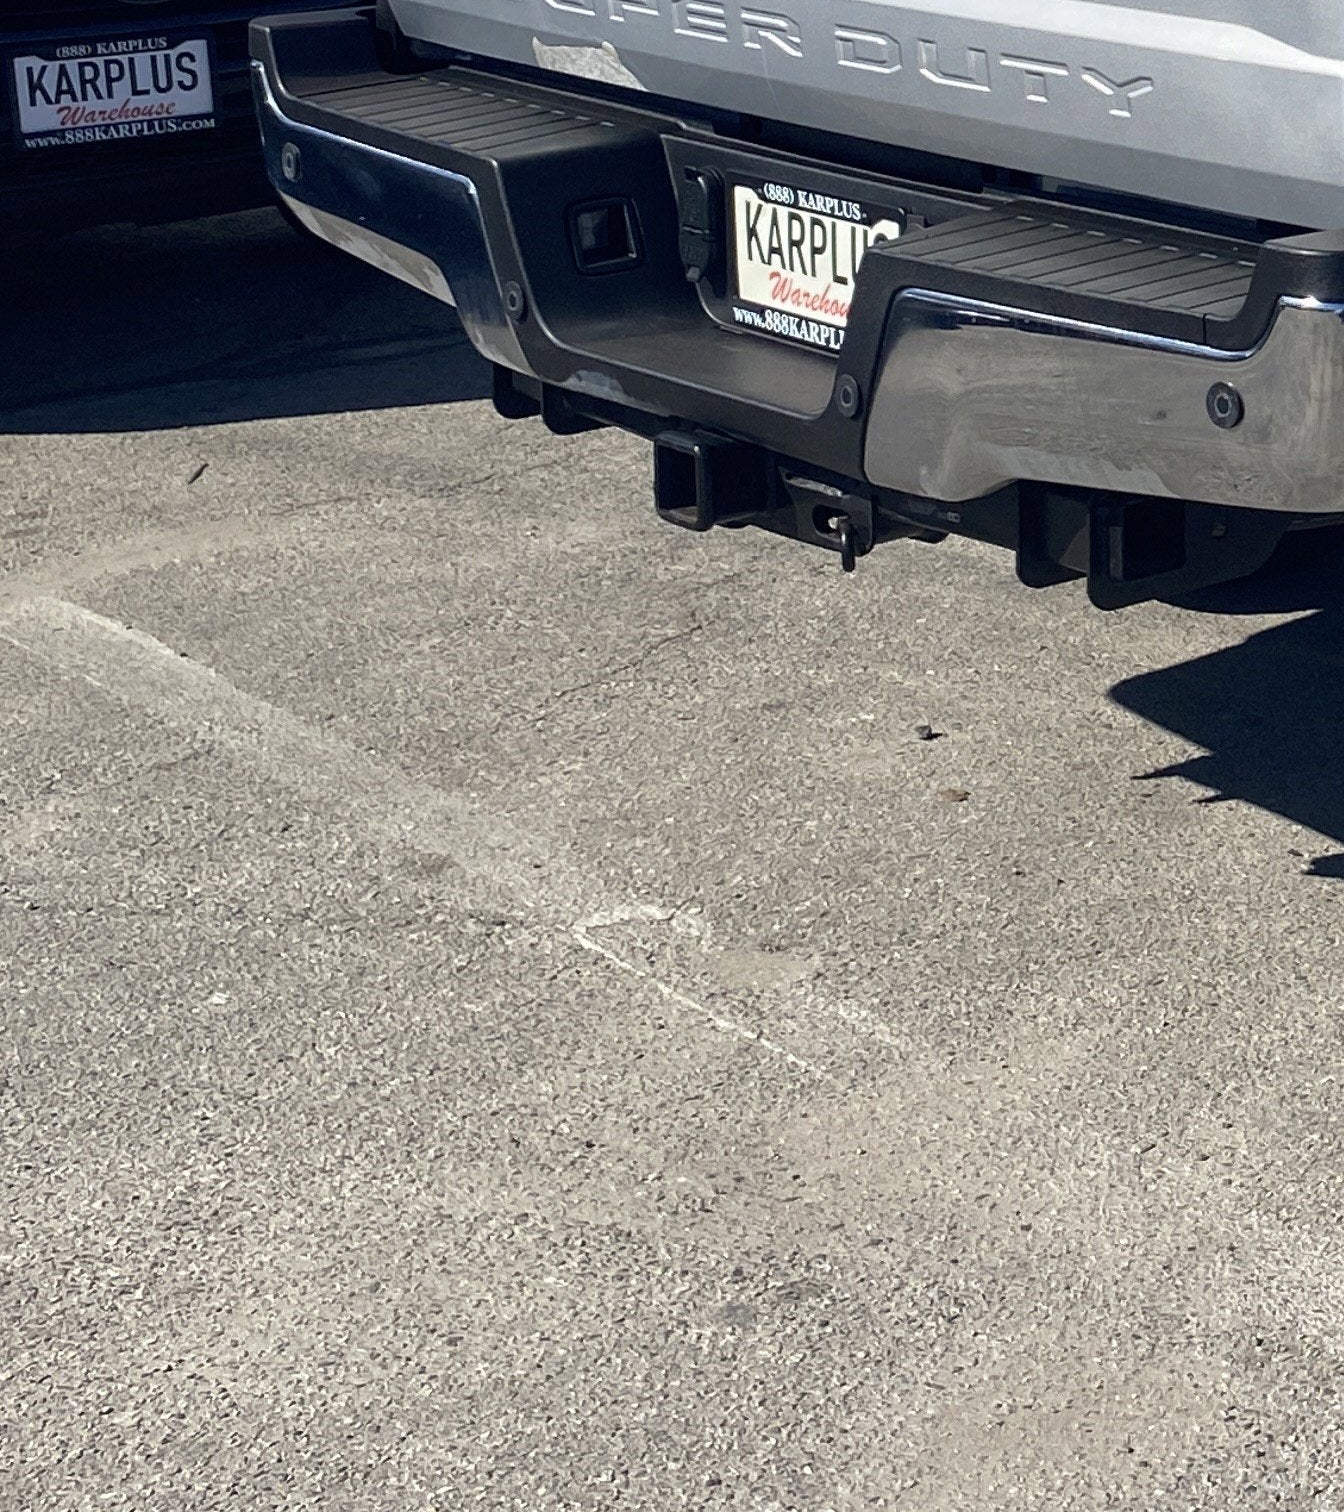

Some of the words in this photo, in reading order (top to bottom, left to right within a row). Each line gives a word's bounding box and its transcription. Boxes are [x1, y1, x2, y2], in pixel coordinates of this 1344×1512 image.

[56, 44, 92, 58] (888)
[96, 37, 168, 55] KARPLUS
[833, 23, 1154, 118] DUTY
[26, 51, 199, 107] KARPLUS
[56, 98, 176, 127] Warehouse
[763, 182, 795, 204] (888)
[797, 189, 861, 220] KARPLUS
[745, 200, 888, 285] KARPLU
[769, 271, 853, 318] Warehou
[733, 306, 846, 351] www.888KARPL
